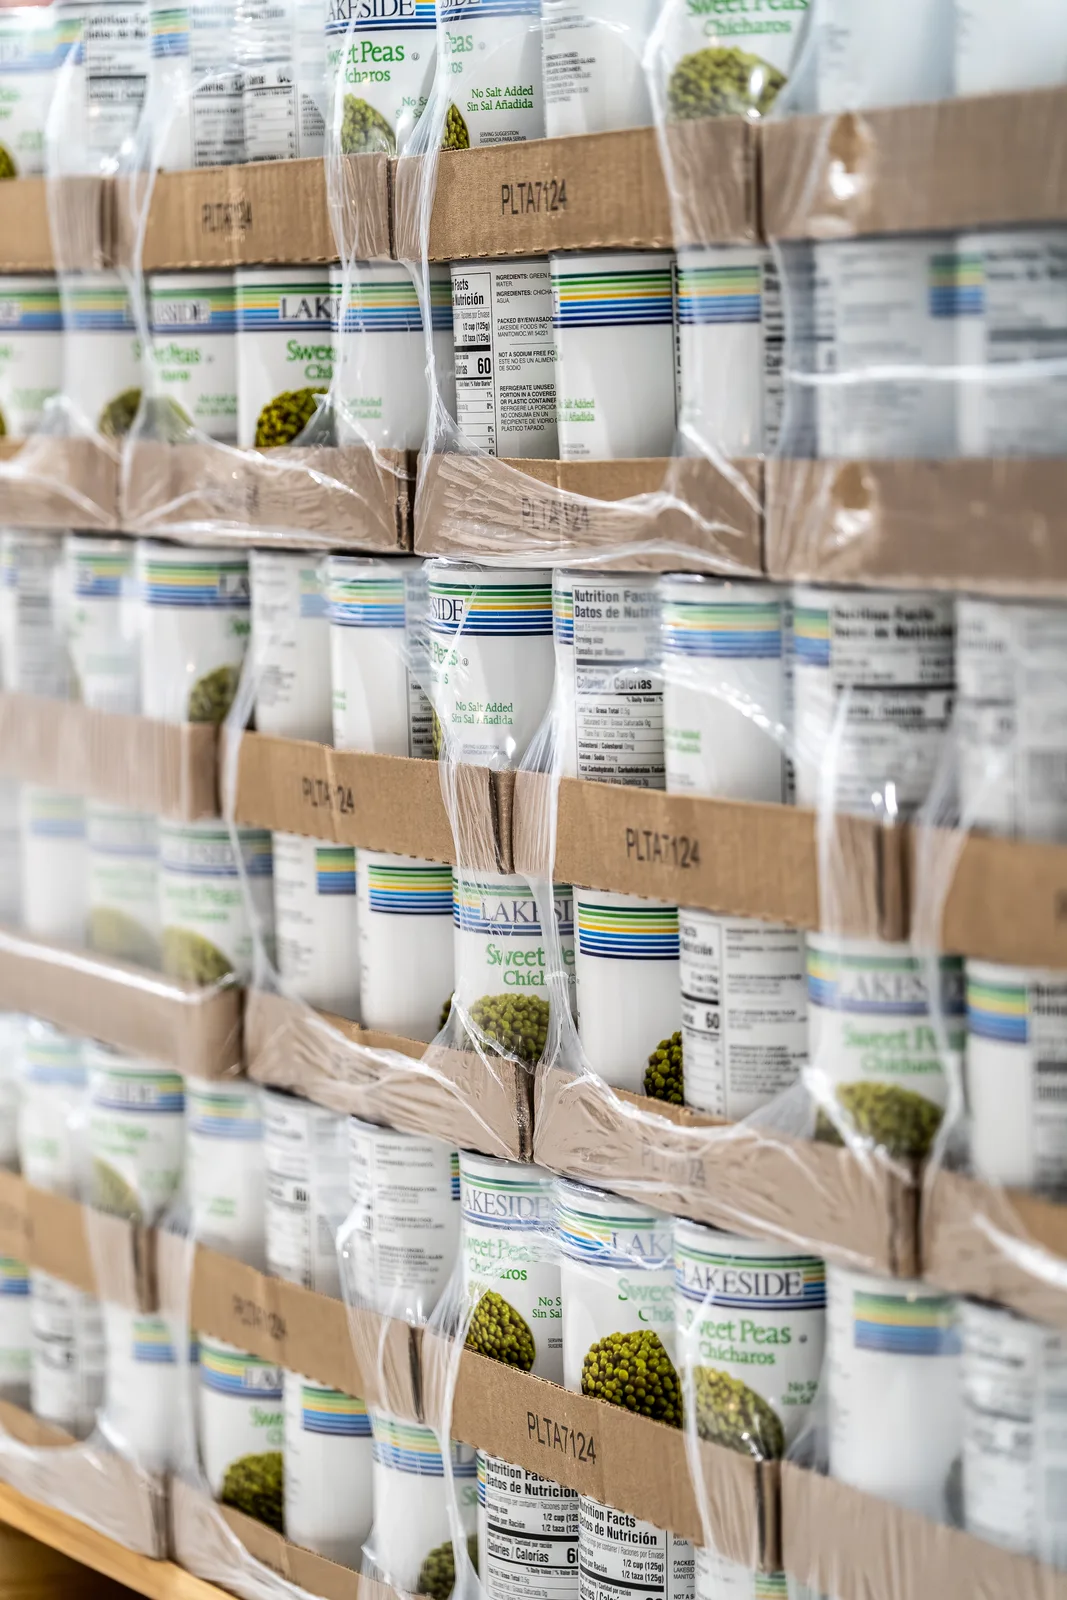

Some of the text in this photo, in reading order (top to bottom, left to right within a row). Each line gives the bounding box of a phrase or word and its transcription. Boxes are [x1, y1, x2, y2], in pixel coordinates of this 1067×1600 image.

[360, 40, 405, 63] Peas
[471, 85, 534, 99] No Salt Added
[402, 96, 416, 107] No
[467, 98, 534, 112] Sin Sal Añadida
[501, 179, 568, 216] PLTA7124
[454, 278, 469, 291] Facts
[455, 292, 484, 306] Nutrición
[477, 357, 491, 374] 60
[574, 589, 619, 602] Nutrition
[575, 605, 619, 619] Datos de
[456, 701, 513, 713] No Salt Added
[452, 713, 475, 724] Sin Sal
[626, 827, 702, 869] PLTA7124
[487, 943, 546, 966] Sweet
[538, 1297, 553, 1306] No
[532, 1308, 547, 1318] Sin
[740, 1319, 792, 1345] Peas
[527, 1411, 596, 1465] PLTA7124
[486, 1459, 522, 1479] Nutrition
[509, 1482, 521, 1493] de
[542, 1513, 552, 1521] 1/2
[554, 1514, 565, 1522] cup
[607, 1510, 636, 1529] Facts
[541, 1524, 551, 1532] 1/2
[552, 1524, 565, 1532] taza
[595, 1522, 605, 1536] de
[607, 1525, 657, 1546] Nutrición
[516, 1547, 549, 1563] Calorías
[620, 1547, 639, 1557] Raciones
[623, 1558, 664, 1572] 1/2 cup (125g)
[622, 1570, 664, 1584] 1/2 taza (125g)
